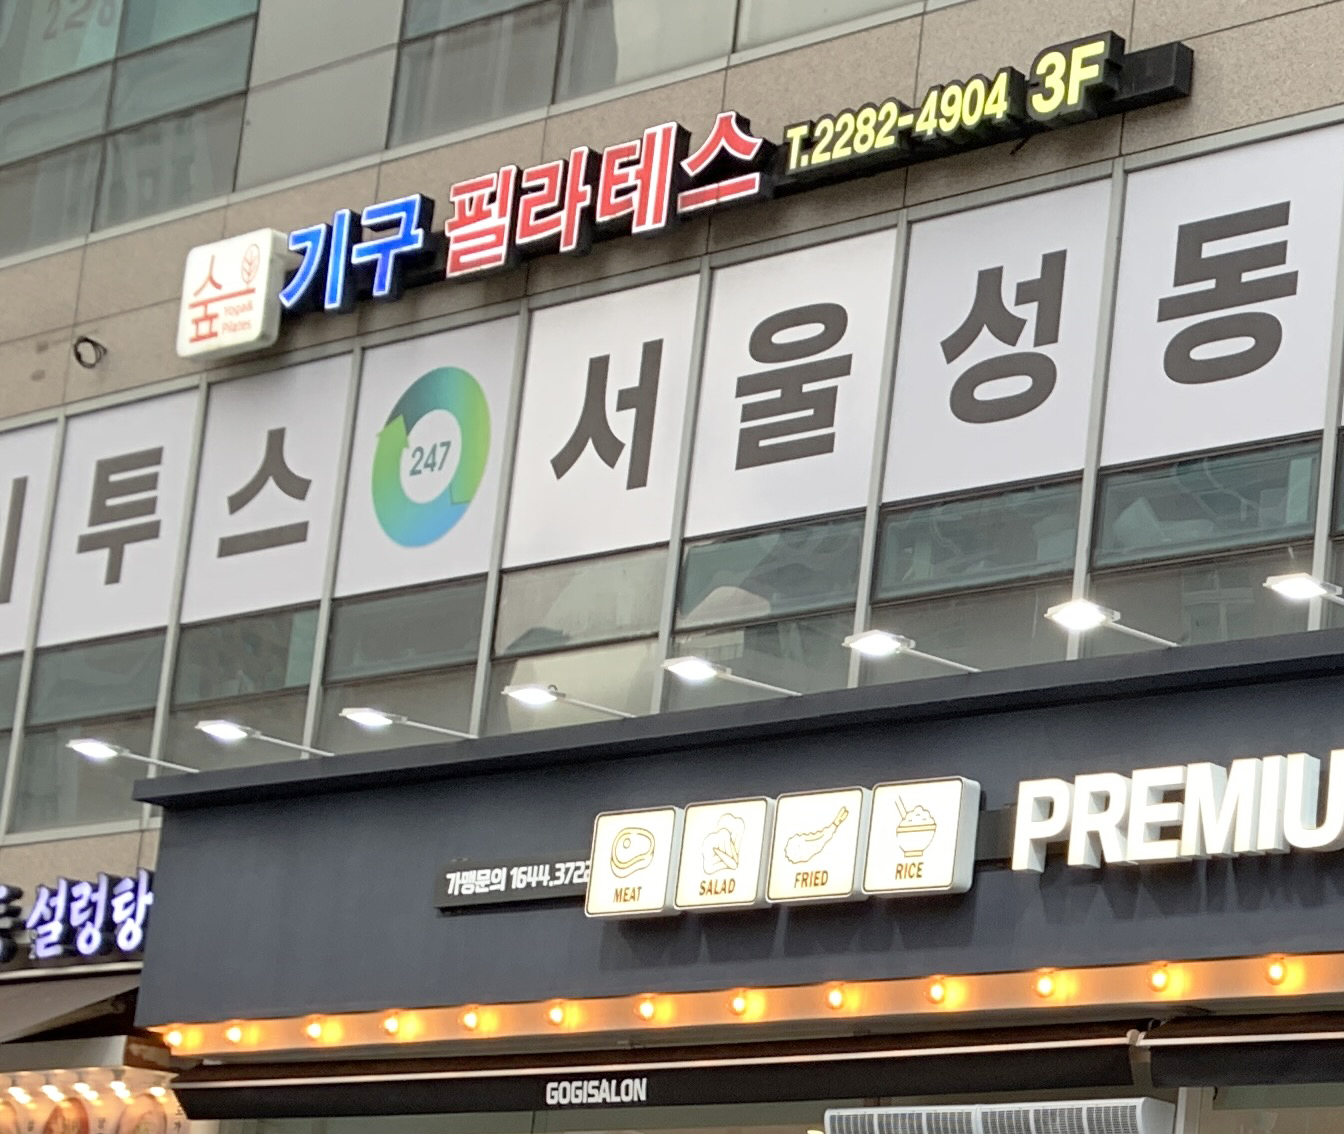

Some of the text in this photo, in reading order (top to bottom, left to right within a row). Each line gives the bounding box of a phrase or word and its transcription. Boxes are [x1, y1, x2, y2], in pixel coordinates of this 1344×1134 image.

[786, 41, 1106, 174] T.2282-4904 3F
[279, 110, 764, 310] 기구 필라테스
[410, 441, 451, 479] 247
[446, 867, 506, 896] 가맹문의
[793, 869, 829, 889] FRIED
[894, 861, 923, 880] RICE
[613, 886, 642, 903] MEAT
[698, 879, 736, 897] SALAD
[26, 868, 154, 958] 설렁탕
[546, 1077, 647, 1105] GOGISALON
